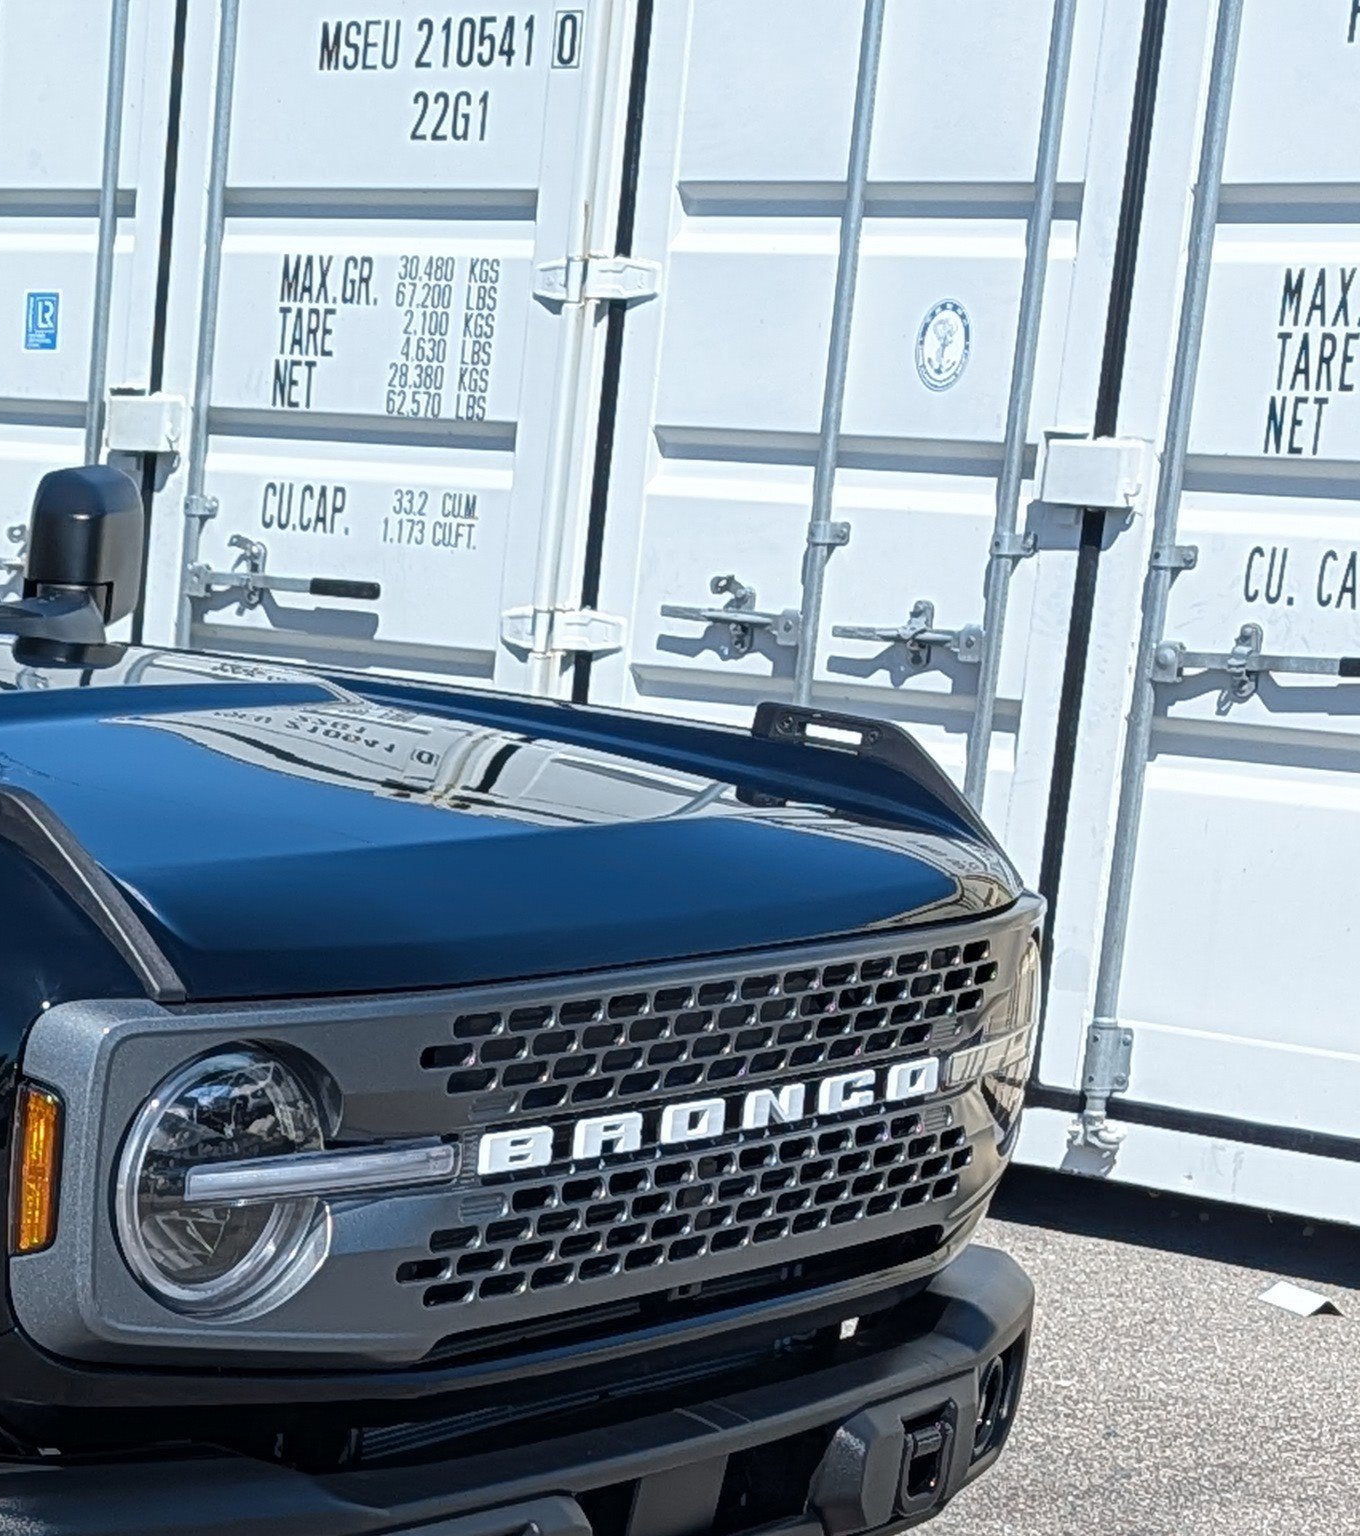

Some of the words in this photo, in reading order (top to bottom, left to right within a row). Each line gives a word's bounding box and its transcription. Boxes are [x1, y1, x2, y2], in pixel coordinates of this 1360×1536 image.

[318, 19, 402, 71] MSEU
[414, 15, 535, 69] 210541
[555, 12, 580, 67] 0
[410, 90, 490, 142] 22G1
[279, 253, 378, 306] MAX.GR.
[398, 255, 455, 283] 30.480
[468, 257, 501, 284] KGS
[395, 282, 453, 309] 67.200
[465, 285, 498, 311] LBS
[278, 306, 337, 357] TARE
[463, 312, 495, 339] KGS
[460, 339, 493, 366] LBS
[271, 359, 317, 409] NET
[457, 366, 490, 393] KGS
[1277, 332, 1360, 392] TARE
[455, 393, 487, 421] LBS
[1263, 395, 1329, 456] NET
[392, 488, 429, 517] 33.2
[1243, 545, 1294, 607] CU.
[477, 1056, 940, 1176] BRONCO
